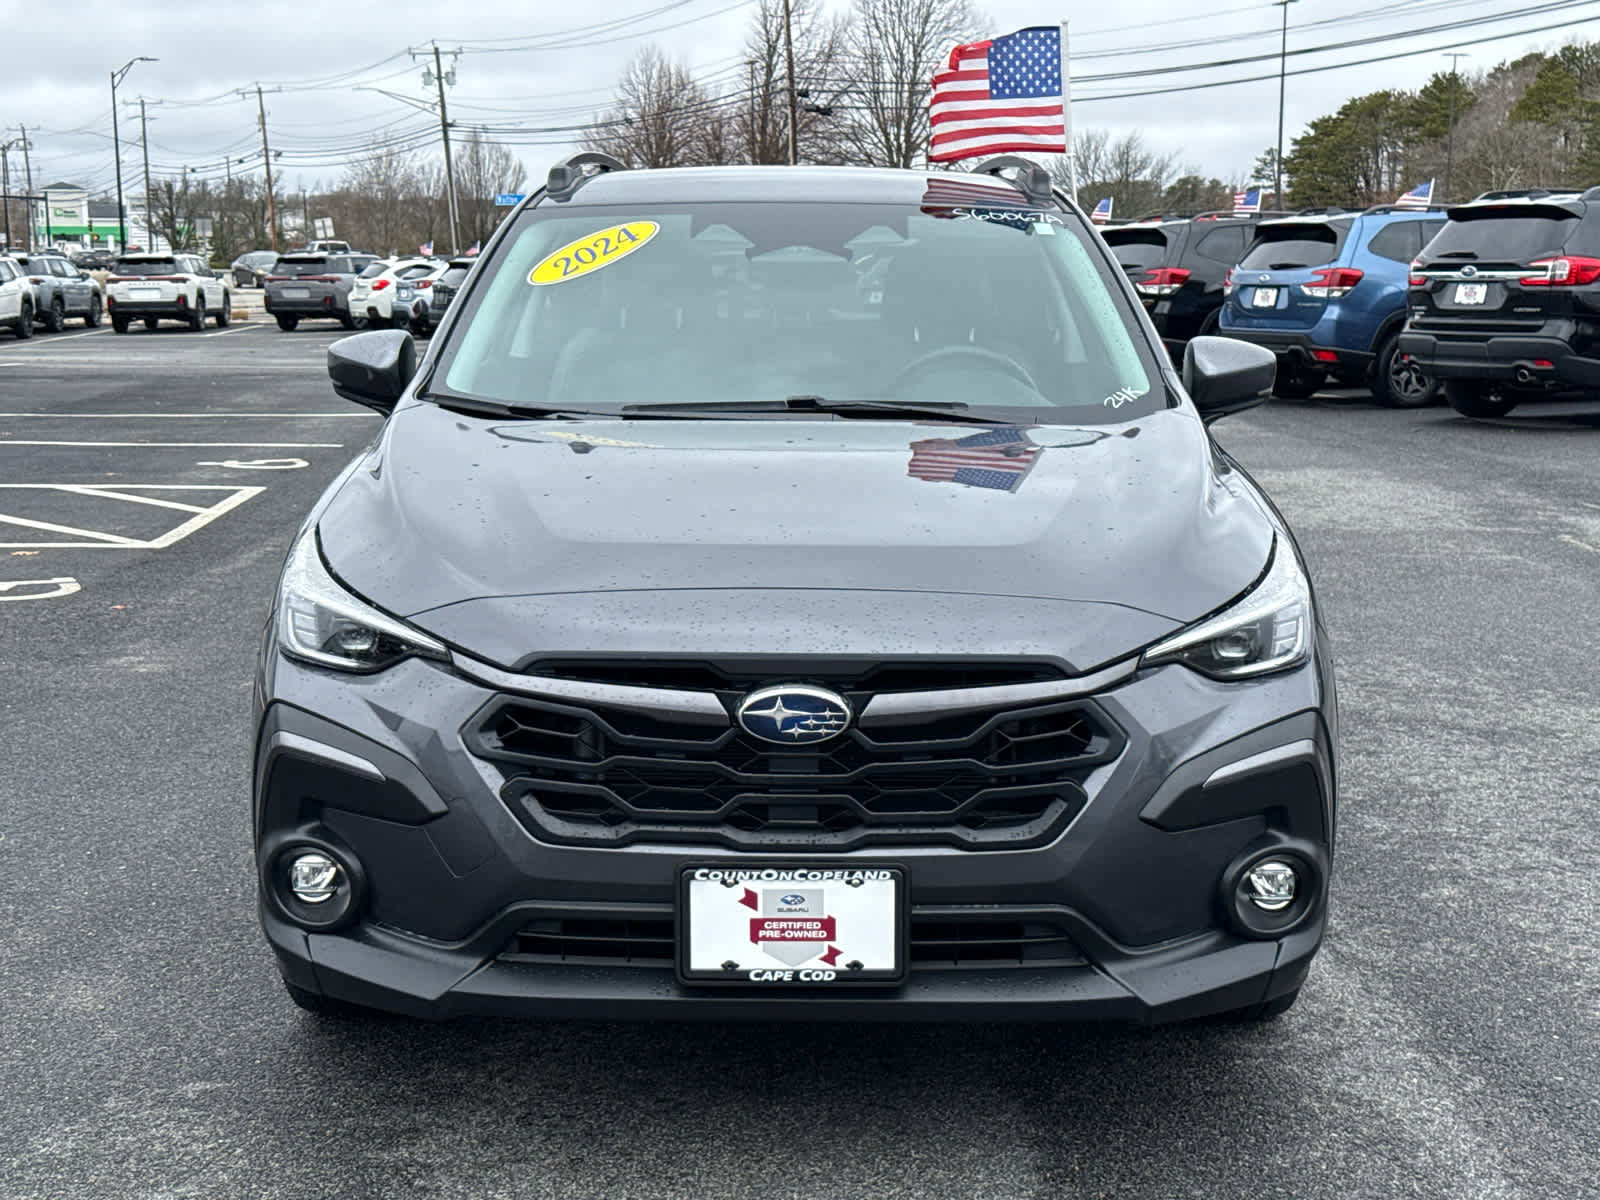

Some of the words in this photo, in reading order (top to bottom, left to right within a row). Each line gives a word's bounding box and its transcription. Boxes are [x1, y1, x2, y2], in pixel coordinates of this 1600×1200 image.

[553, 228, 639, 276] 2024
[1103, 386, 1145, 408] 24K
[764, 921, 821, 930] CERTIFIED
[758, 930, 827, 939] PRE-OWNED
[749, 969, 793, 981] CAPE
[799, 969, 836, 981] COD
